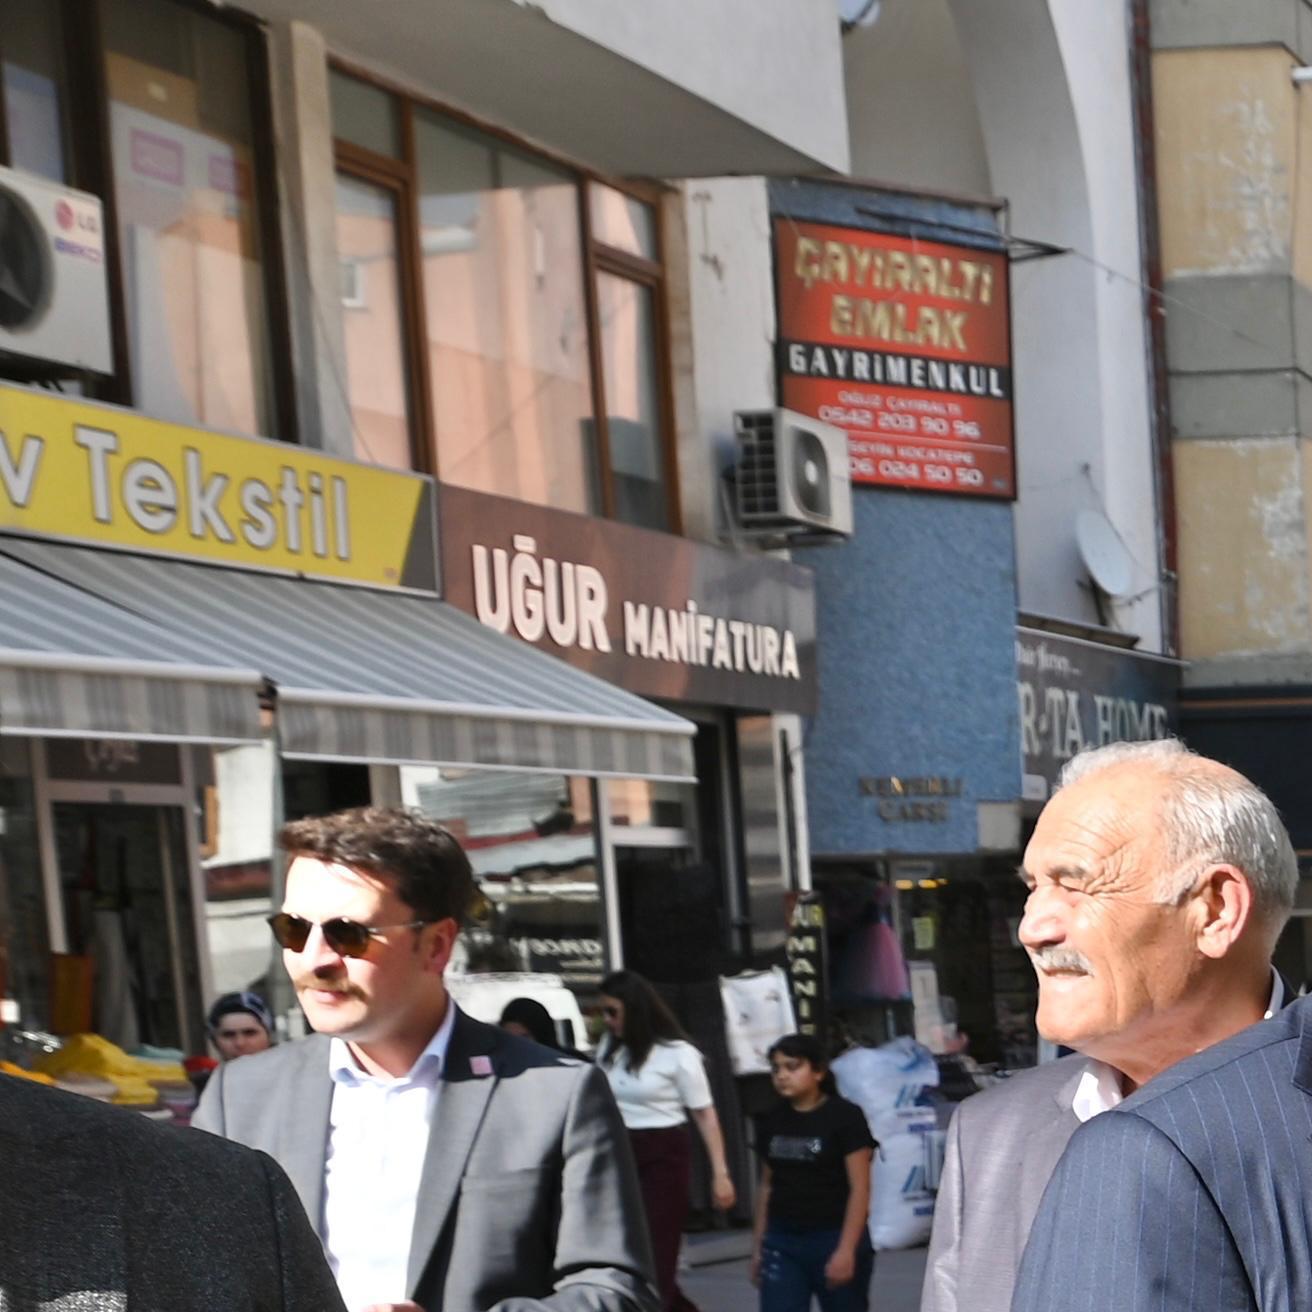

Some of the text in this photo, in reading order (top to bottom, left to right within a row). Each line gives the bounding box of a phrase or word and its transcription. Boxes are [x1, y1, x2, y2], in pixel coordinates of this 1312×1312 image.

[831, 293, 967, 352] EMLAK
[73, 423, 350, 561] Tekstil
[473, 534, 801, 680] UĞUR MANİFATURA
